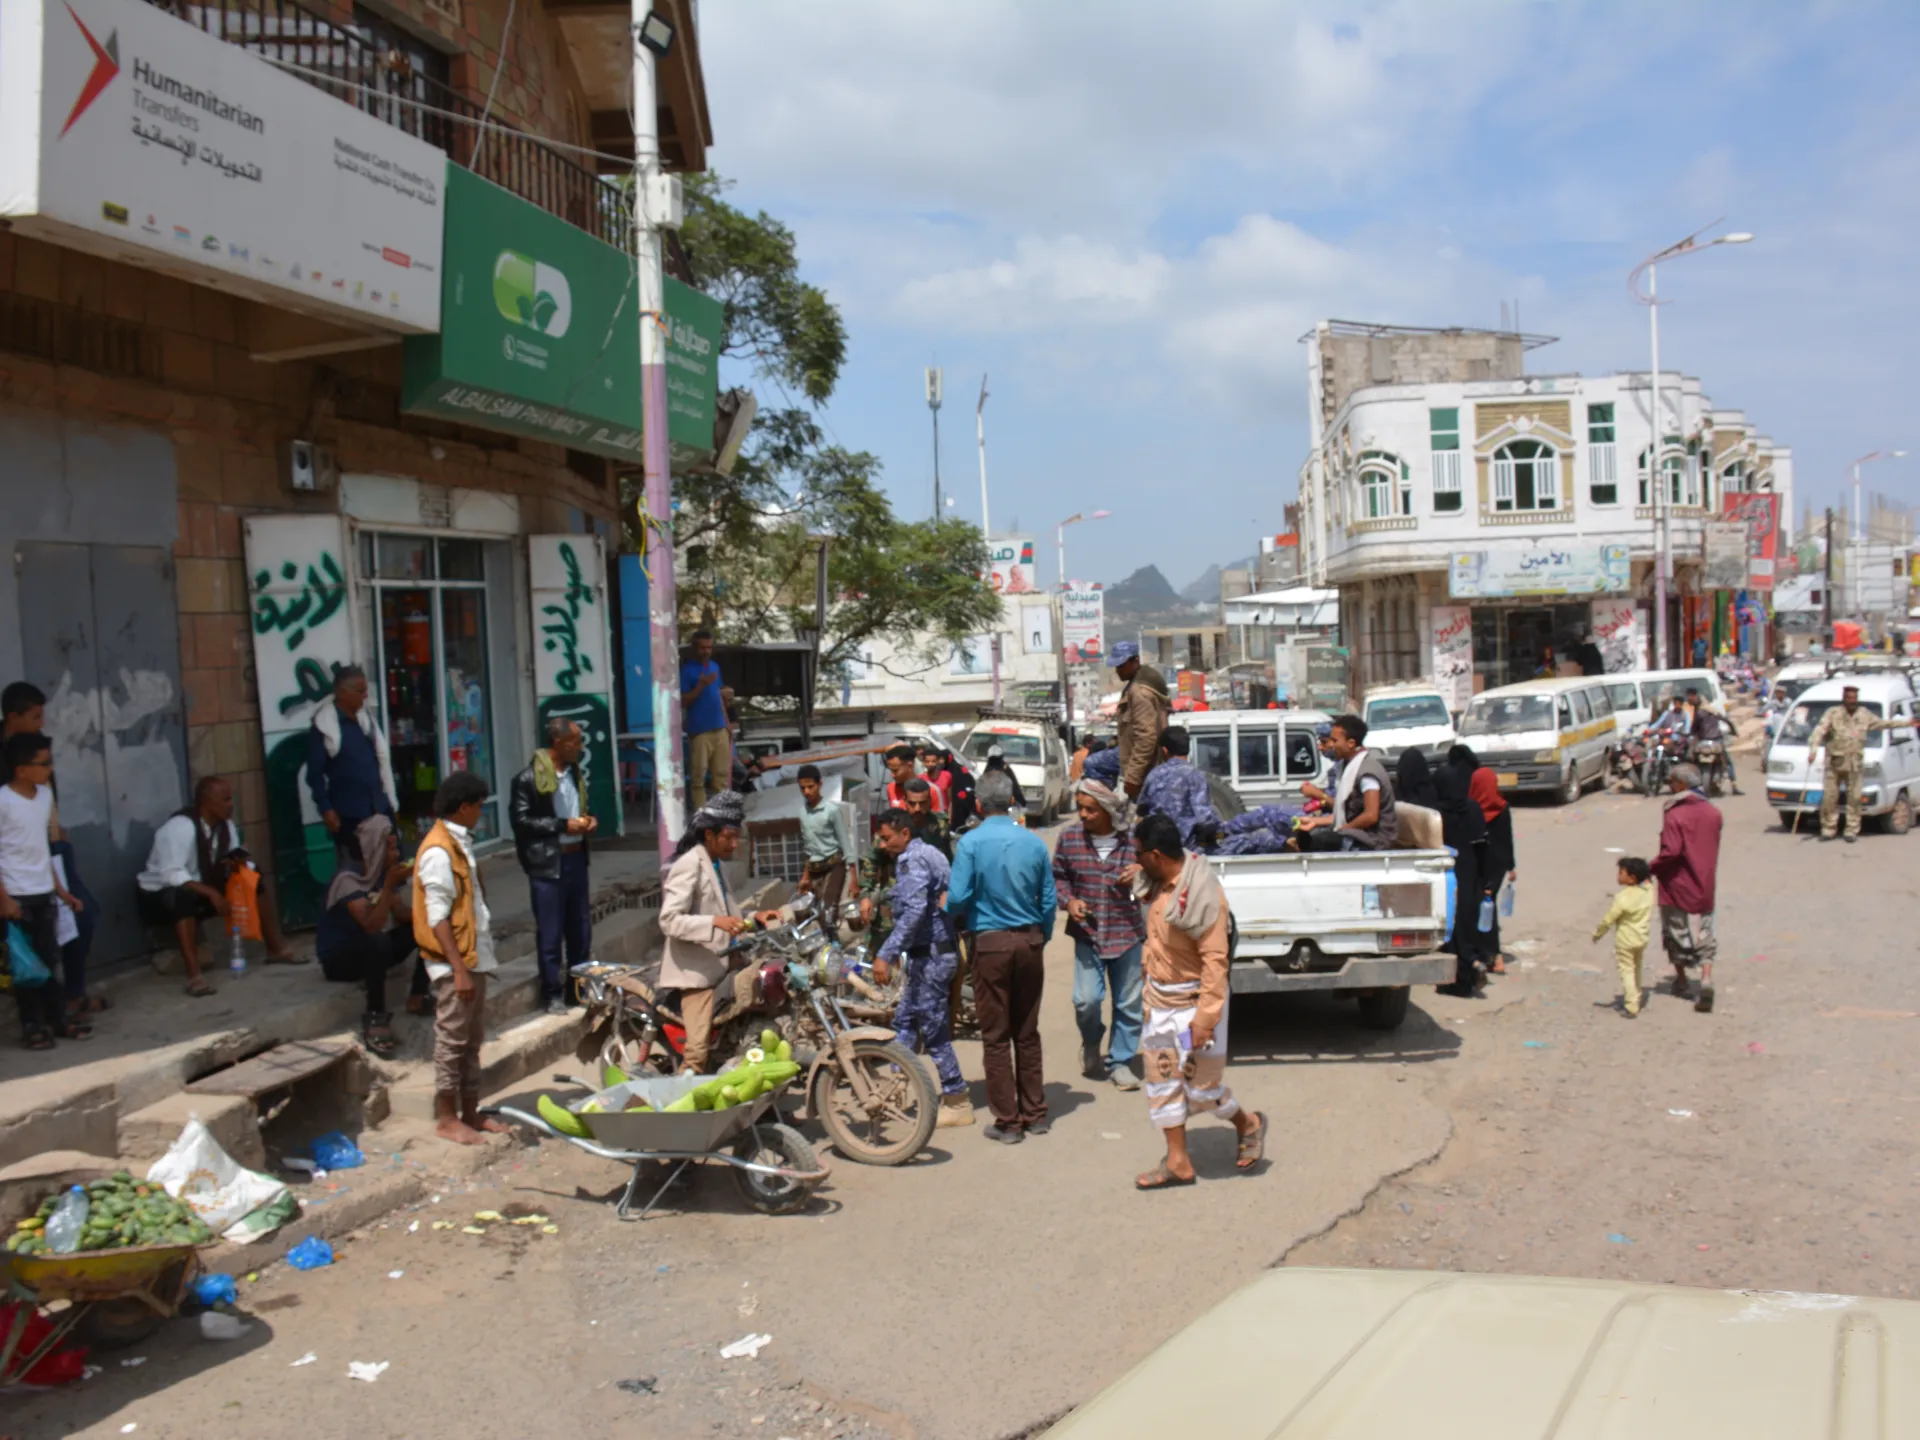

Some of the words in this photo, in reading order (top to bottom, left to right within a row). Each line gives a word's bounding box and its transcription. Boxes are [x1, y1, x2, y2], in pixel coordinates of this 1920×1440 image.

[132, 57, 265, 135] Humanitarian
[132, 87, 200, 133] Transfers
[437, 385, 525, 418] ALBALSAM
[517, 405, 593, 437] PHARMACY
